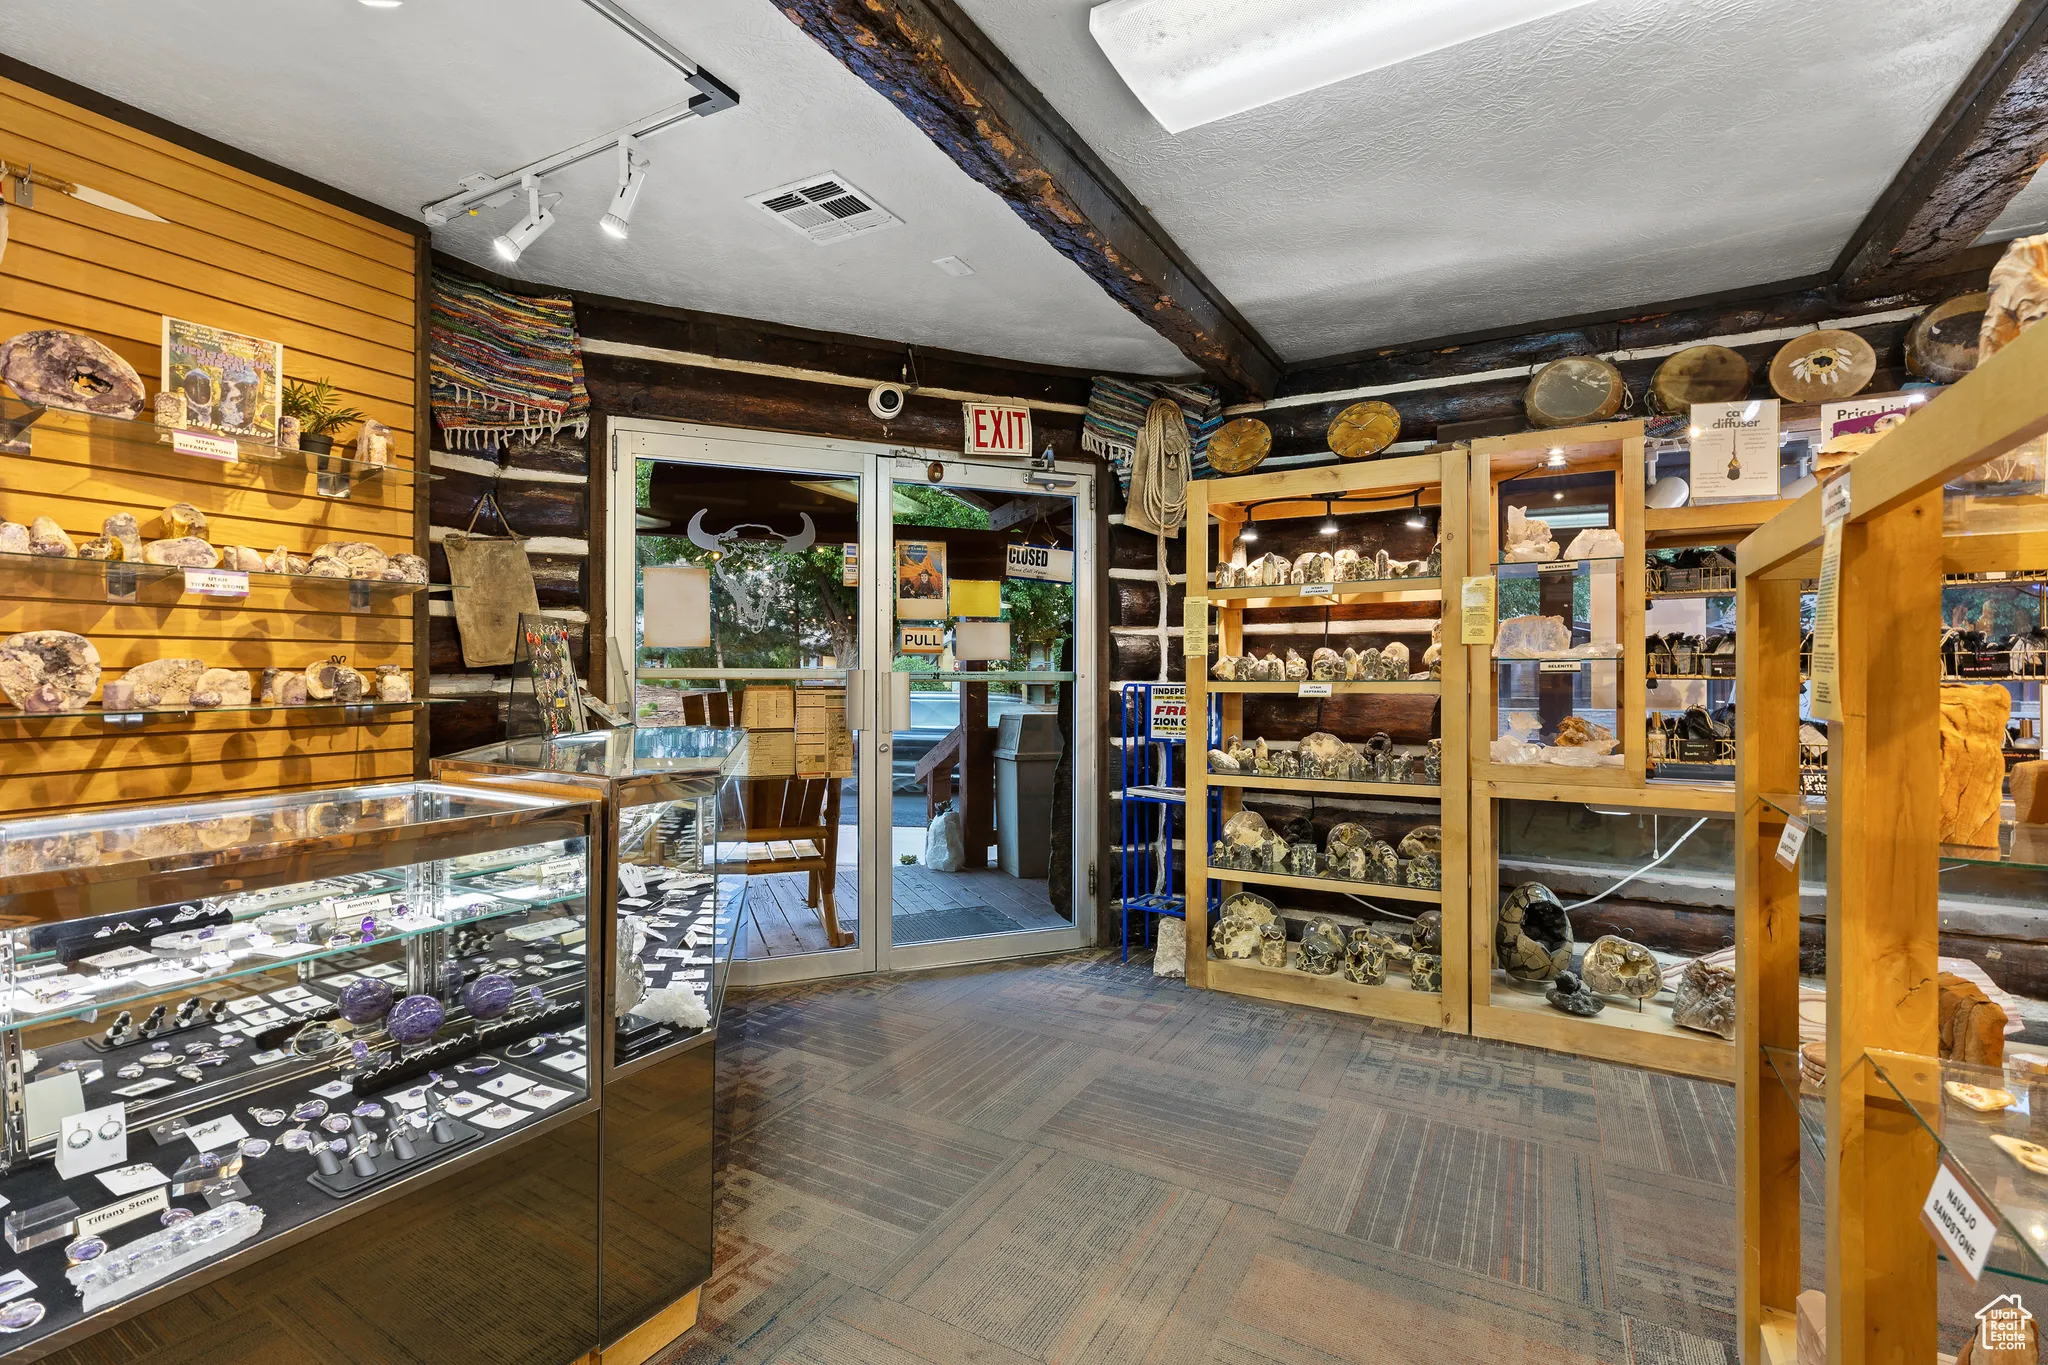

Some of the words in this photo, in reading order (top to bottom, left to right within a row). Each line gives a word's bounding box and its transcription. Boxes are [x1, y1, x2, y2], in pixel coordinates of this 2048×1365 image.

[170, 342, 205, 357] THEN
[246, 358, 272, 371] OUR
[1726, 410, 1745, 418] ca
[974, 409, 1026, 449] EXIT
[1712, 418, 1760, 429] diffuser
[179, 442, 207, 451] TIFFANY
[1009, 547, 1048, 567] CLOSED
[905, 634, 940, 646] PULL
[1153, 718, 1178, 726] ZION
[1803, 774, 1826, 784] sprk
[347, 899, 380, 909] Amethyst
[86, 1207, 125, 1225] Tiffany
[128, 1194, 160, 1210] Stone
[1946, 1188, 1977, 1230] NAVAJO
[1932, 1199, 1977, 1261] SANDSTONE
